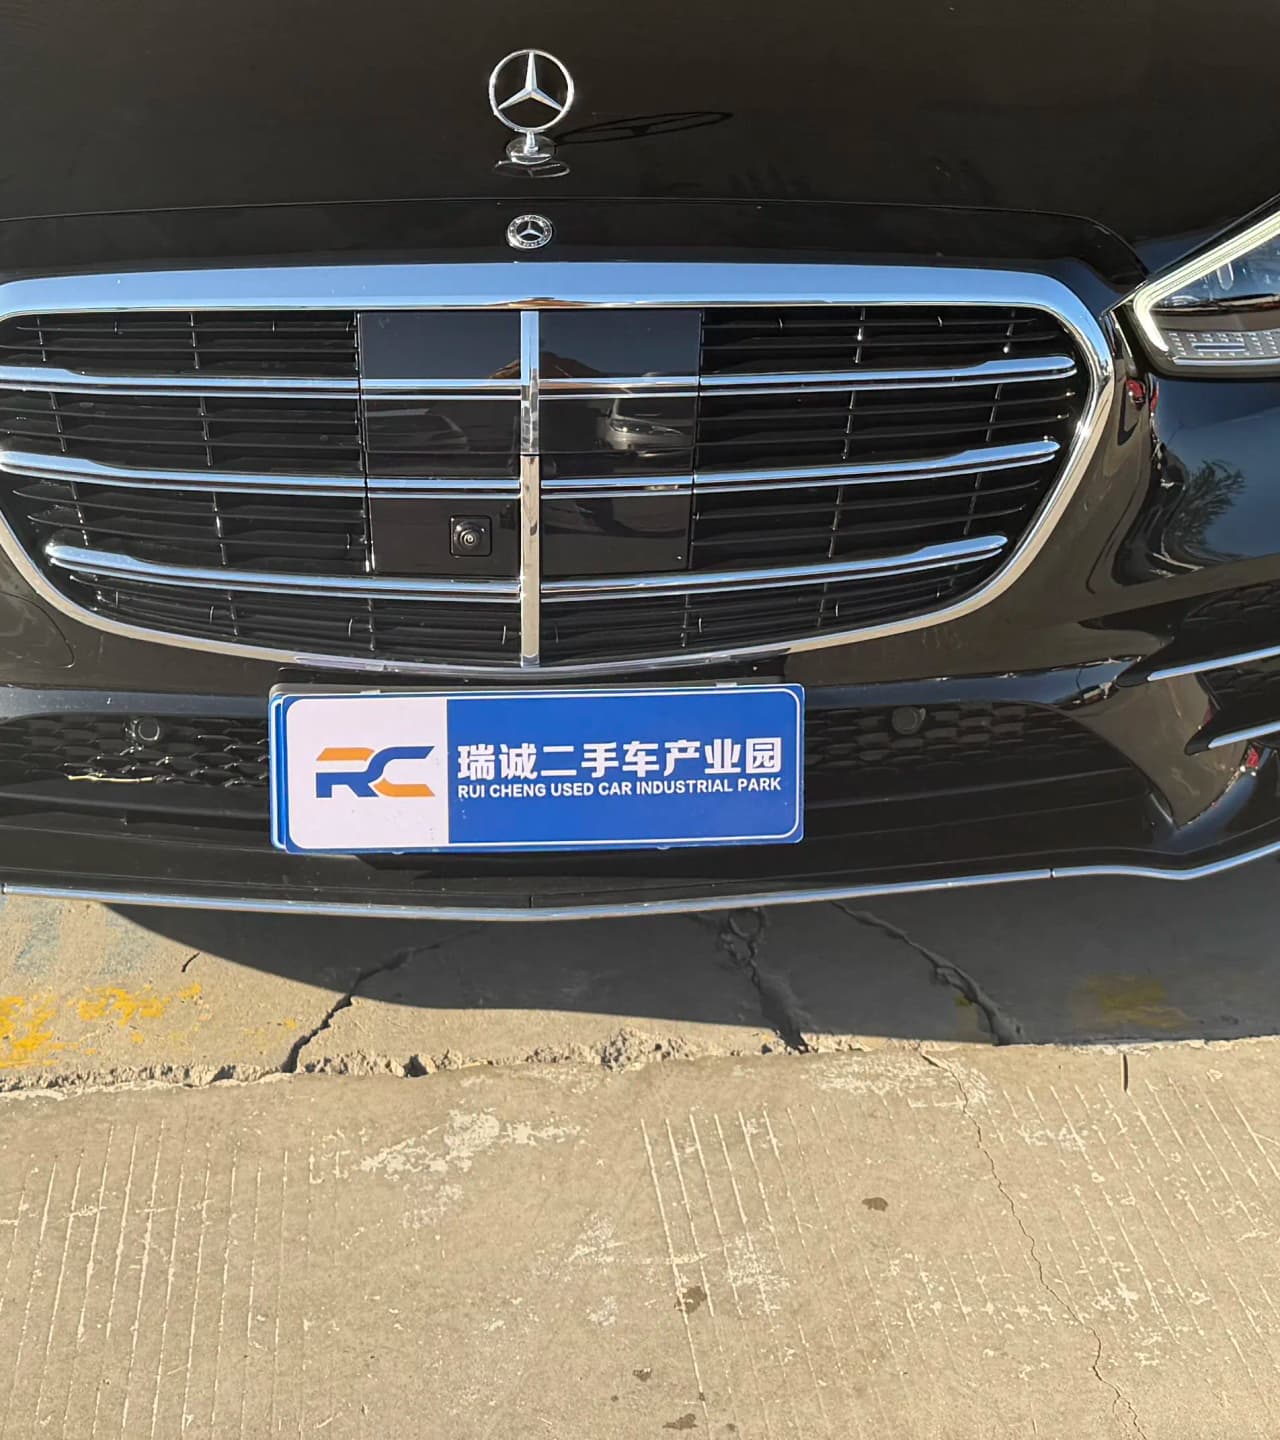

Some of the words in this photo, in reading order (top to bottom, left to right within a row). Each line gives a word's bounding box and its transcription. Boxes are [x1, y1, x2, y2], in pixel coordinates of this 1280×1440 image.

[315, 745, 435, 798] RC
[457, 737, 782, 781] 瑞诚二手车产业园
[458, 783, 486, 799] RUI
[489, 783, 546, 798] CHENG
[550, 782, 594, 797] USED
[598, 780, 632, 796] CAR
[636, 778, 733, 795] INDUSTRIAL
[737, 777, 781, 792] PARK
